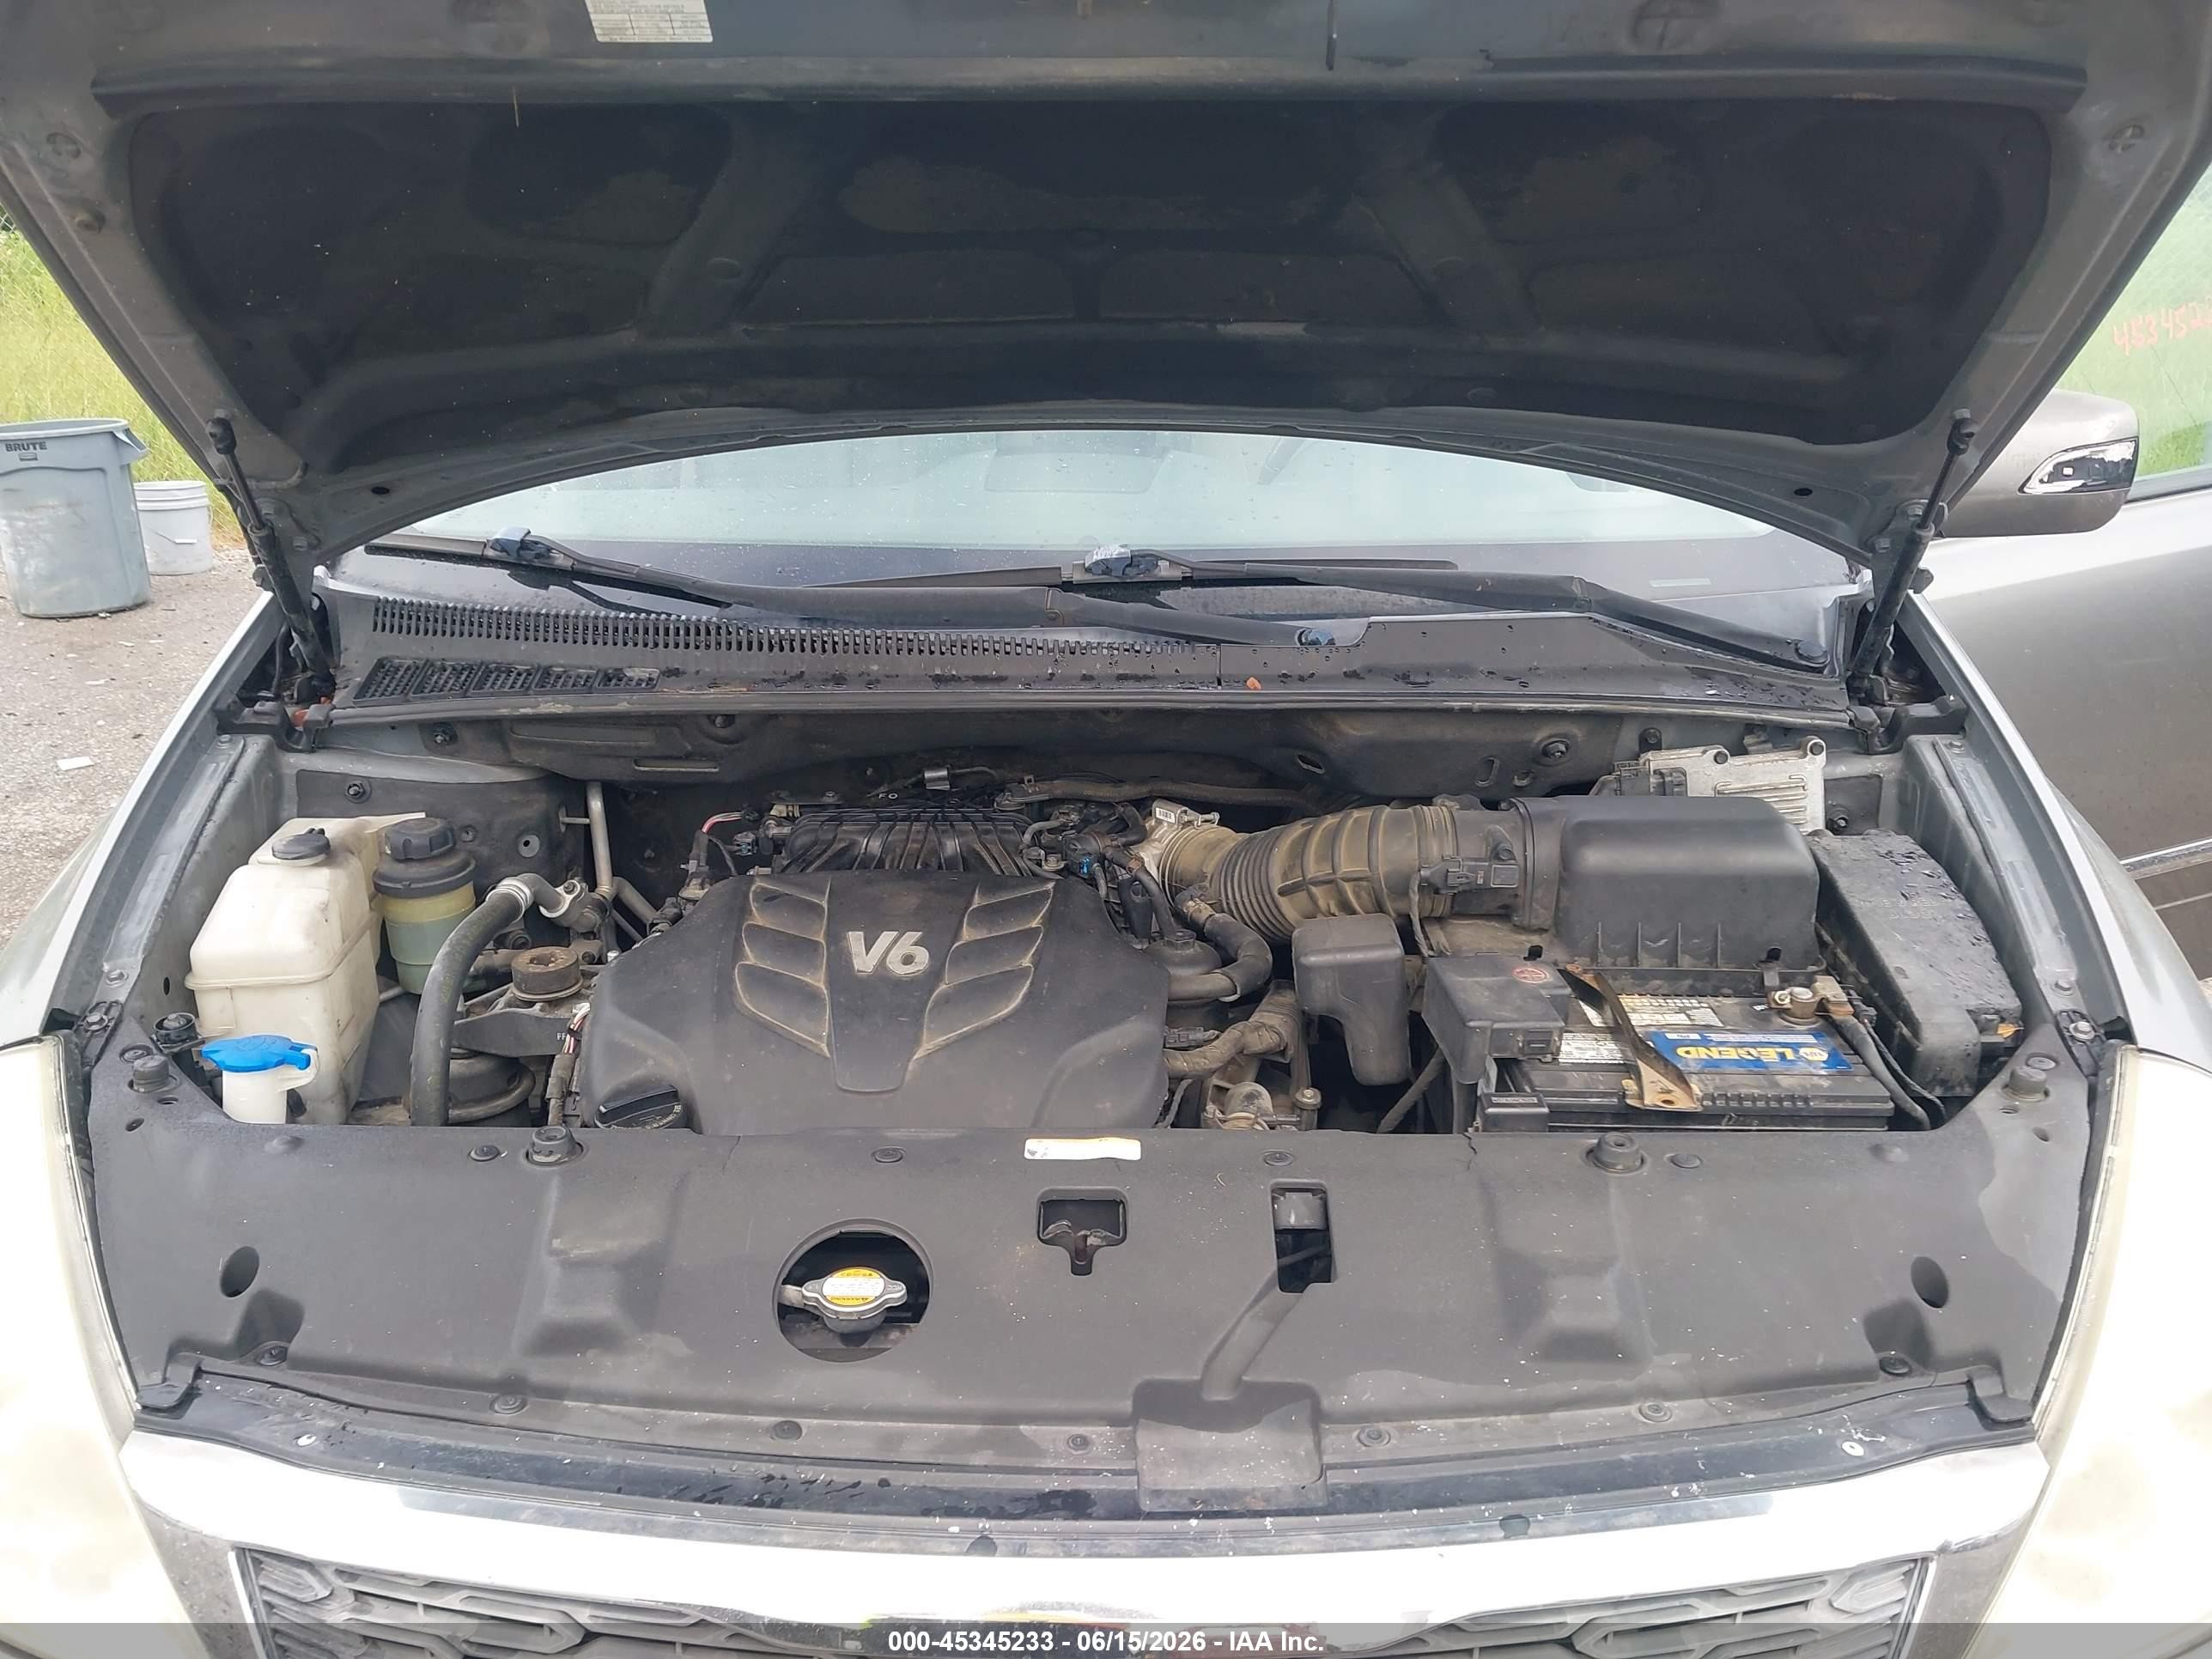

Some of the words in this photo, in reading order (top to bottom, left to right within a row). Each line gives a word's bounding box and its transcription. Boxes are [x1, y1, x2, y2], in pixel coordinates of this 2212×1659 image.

[5, 441, 48, 452] BRUTE
[846, 931, 929, 975] V6
[1676, 1045, 1796, 1062] LEGEND
